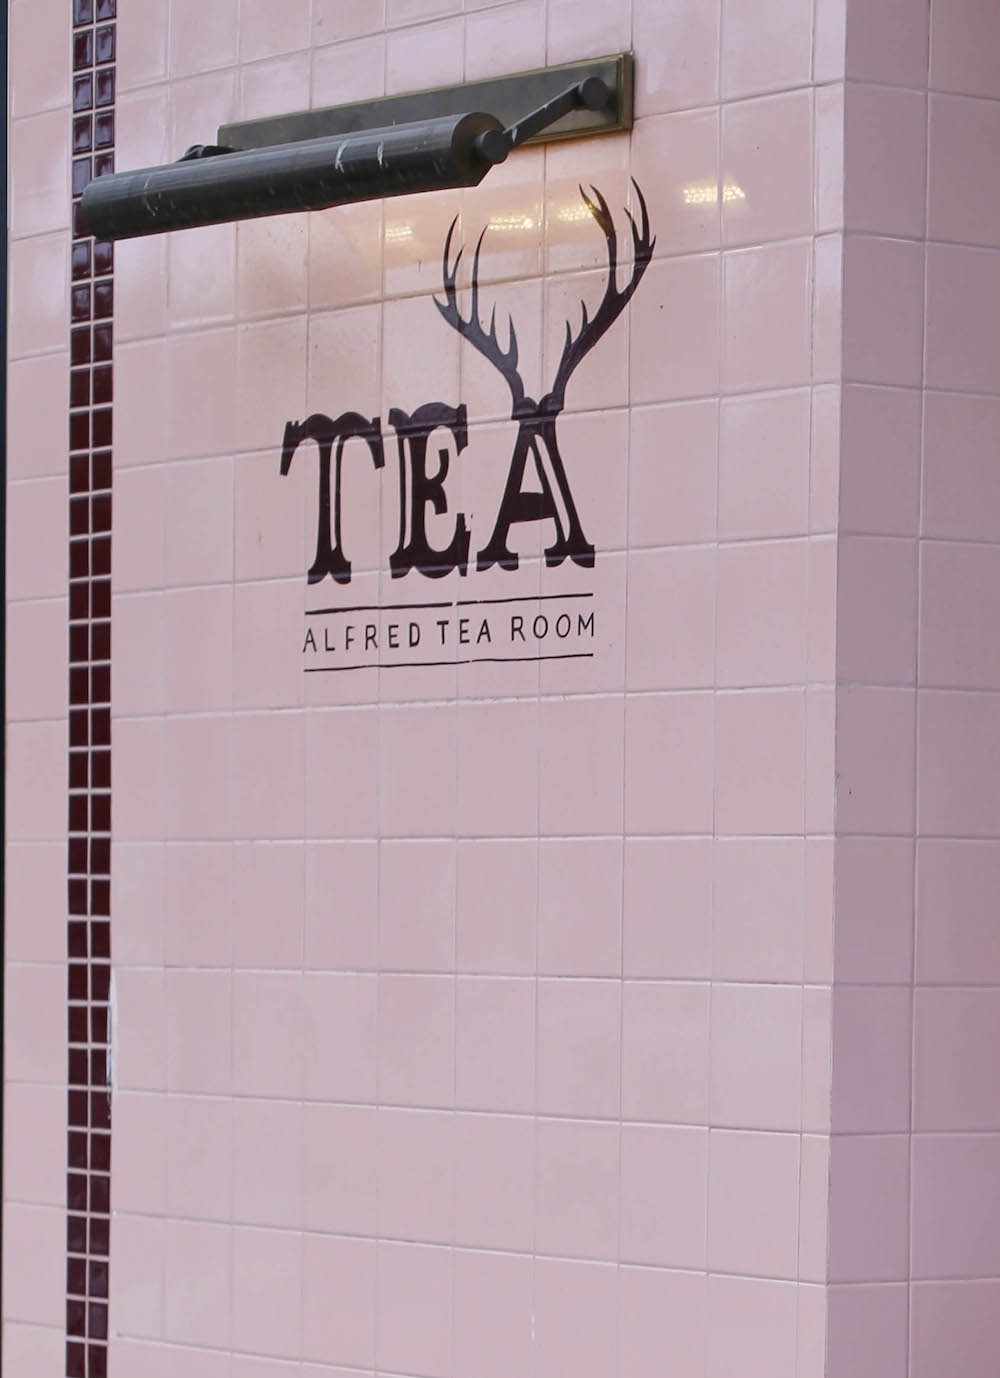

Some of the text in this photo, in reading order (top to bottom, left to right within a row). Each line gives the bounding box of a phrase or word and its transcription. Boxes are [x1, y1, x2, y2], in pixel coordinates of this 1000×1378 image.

[280, 399, 595, 585] TEA
[302, 612, 595, 653] ALFRED TEA ROOM
